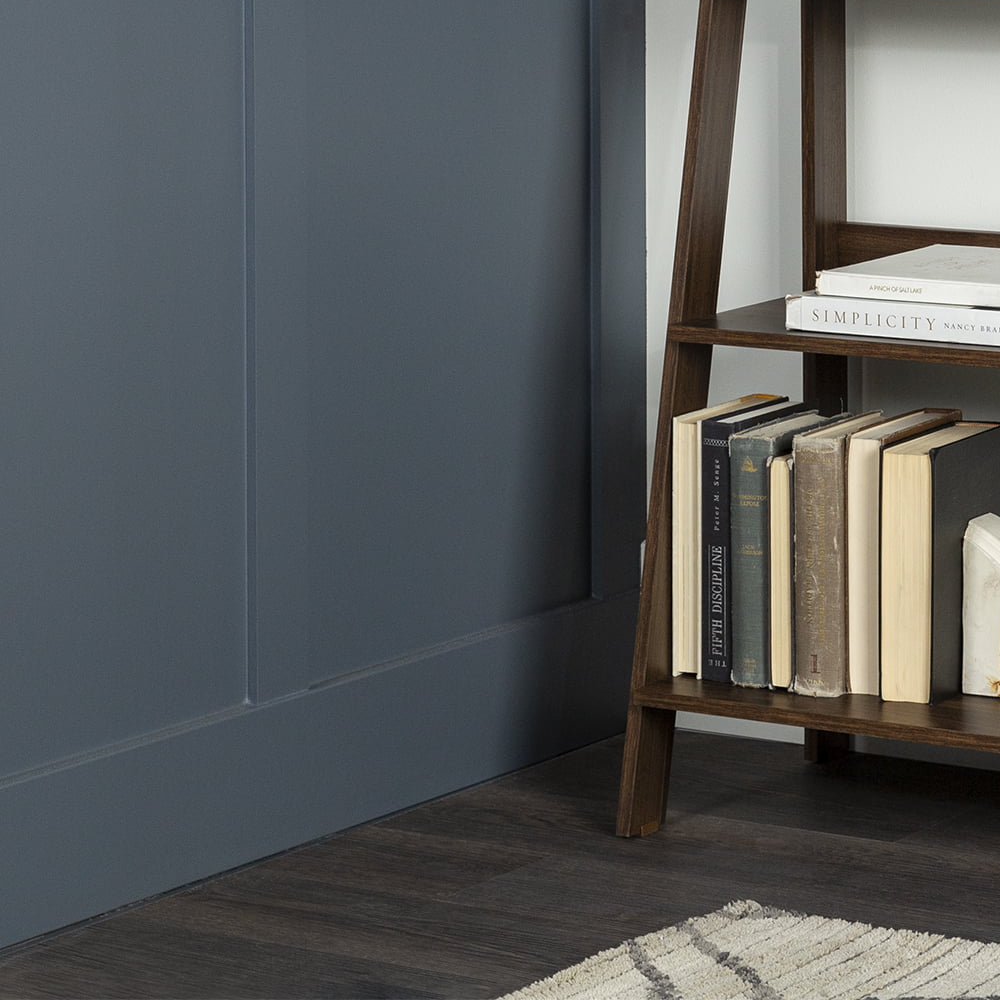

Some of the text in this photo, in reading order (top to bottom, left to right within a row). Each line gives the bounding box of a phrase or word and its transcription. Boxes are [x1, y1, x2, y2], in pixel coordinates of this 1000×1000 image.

[811, 308, 936, 331] SIMPLICITY
[943, 322, 976, 332] NANCY
[713, 459, 721, 486] Senge
[711, 545, 723, 613] DISCIPLINE
[711, 619, 723, 656] FIFTH
